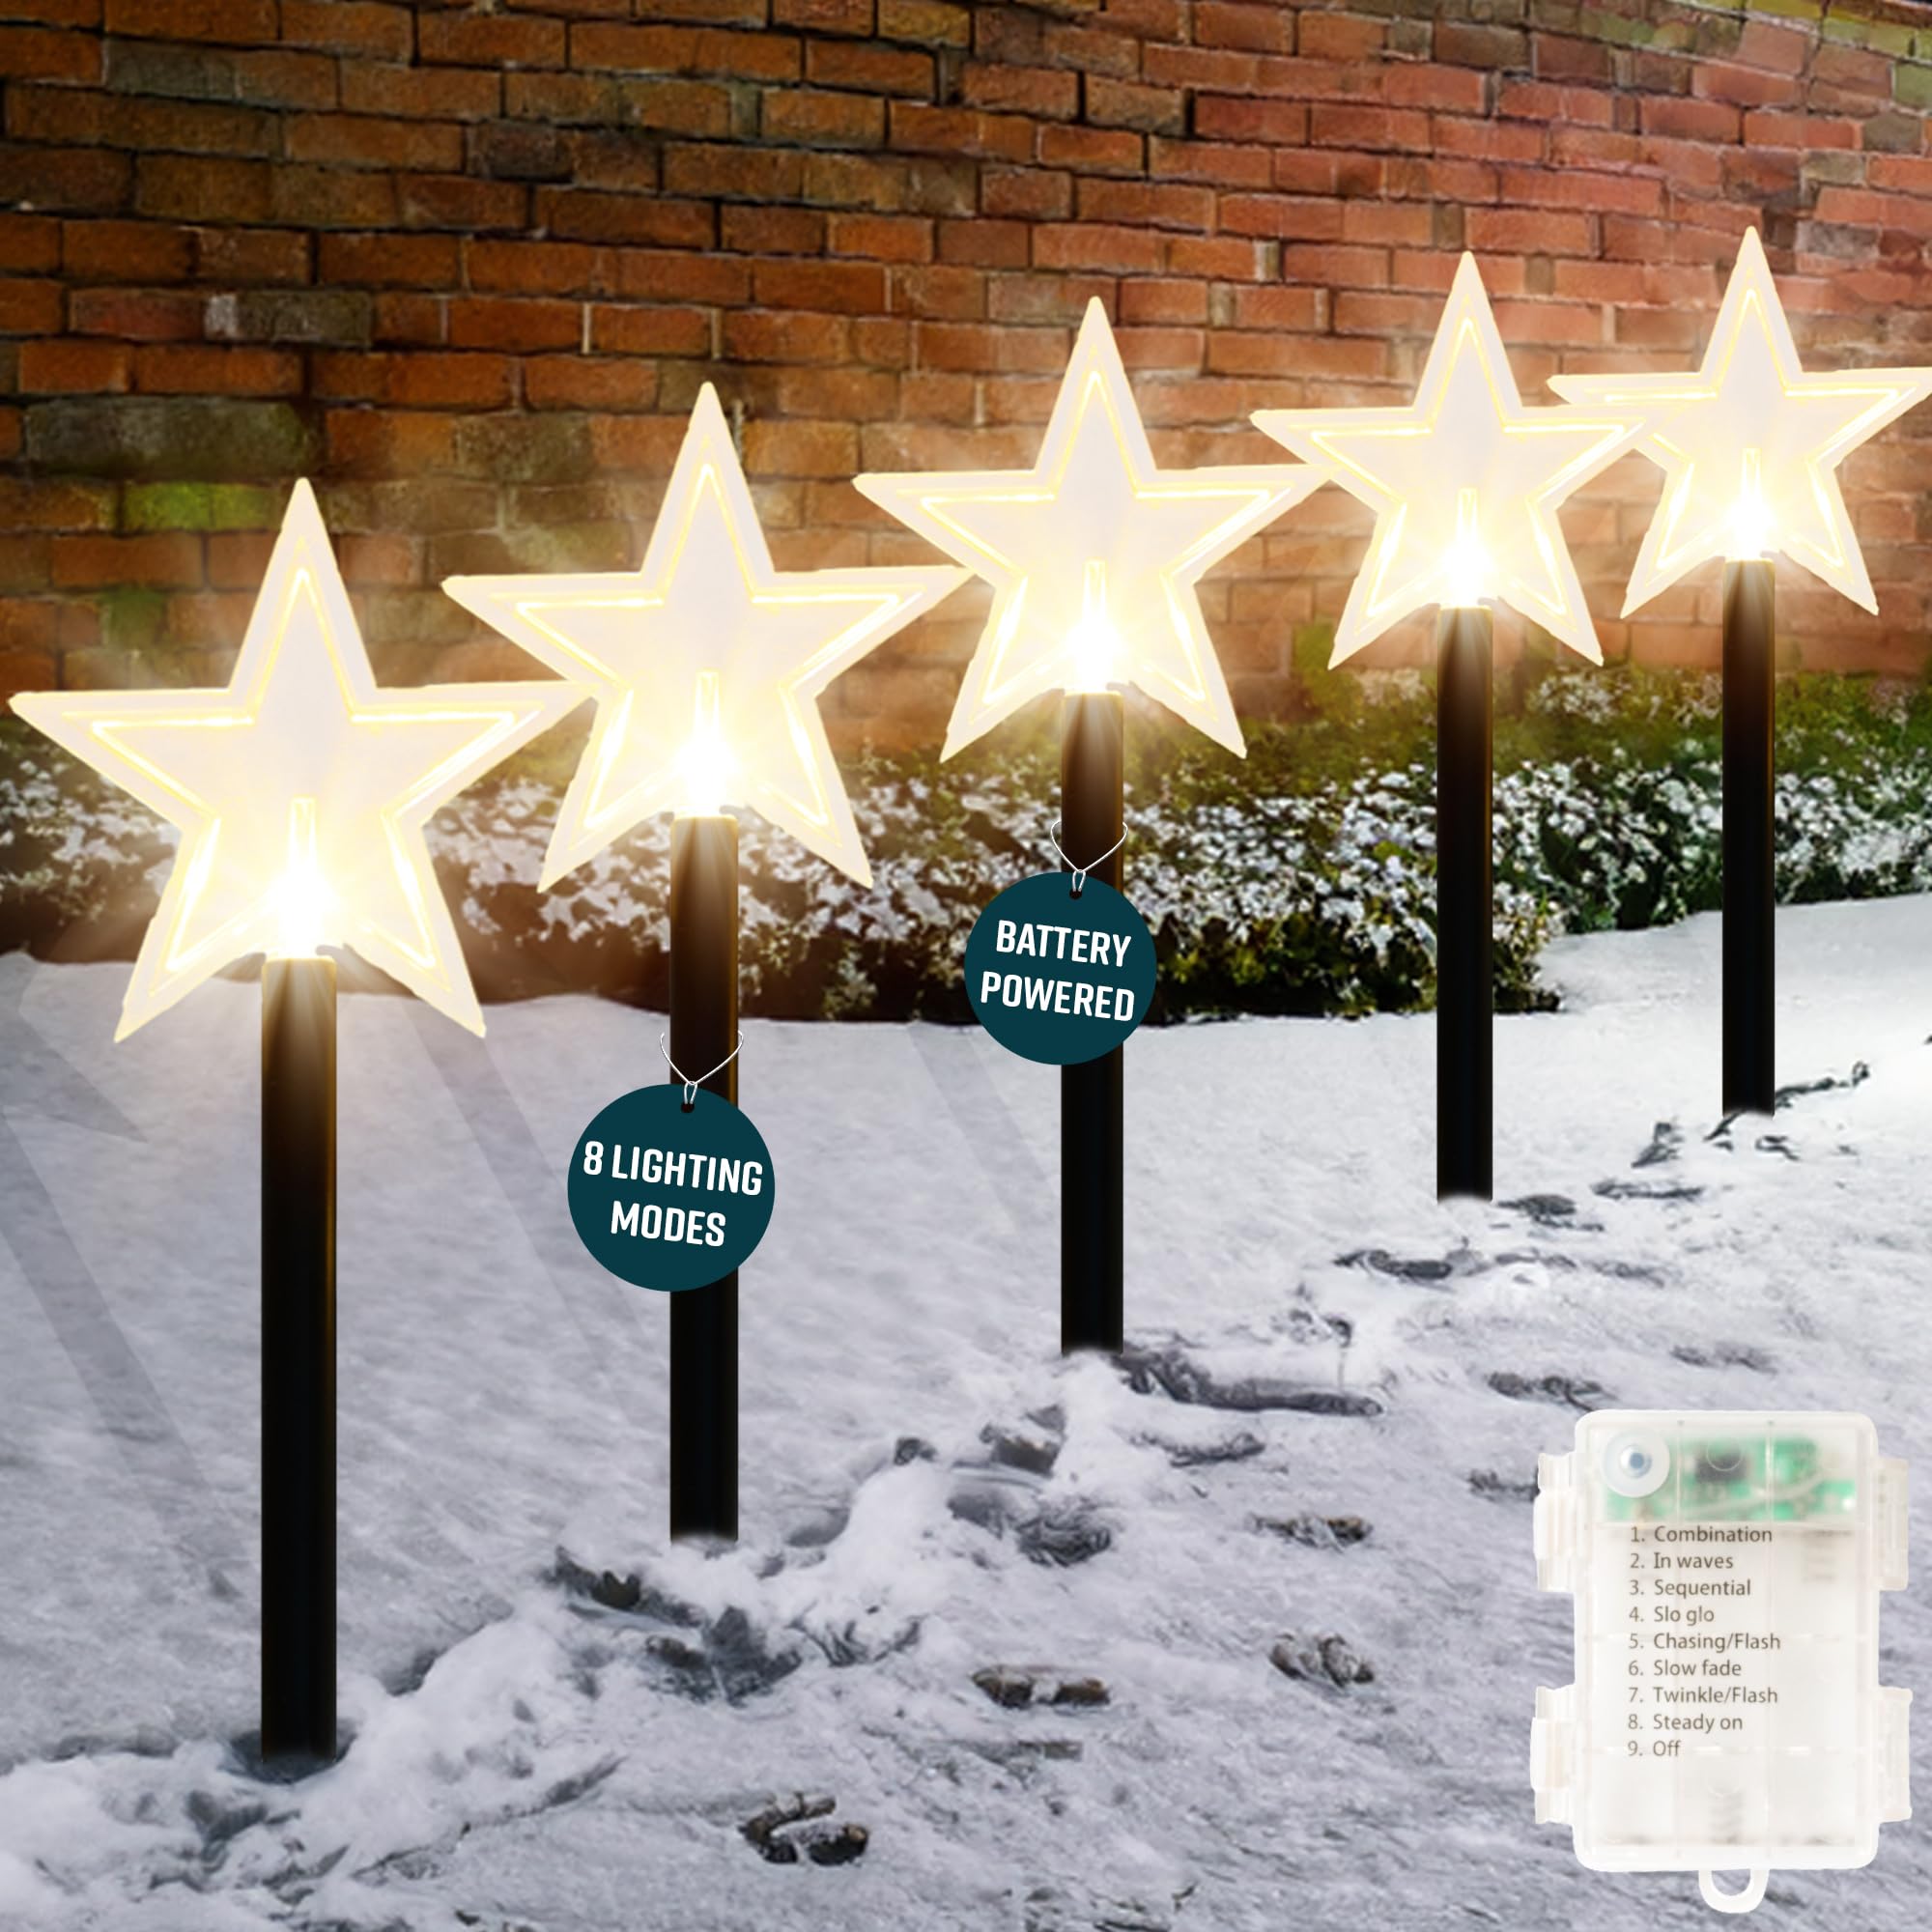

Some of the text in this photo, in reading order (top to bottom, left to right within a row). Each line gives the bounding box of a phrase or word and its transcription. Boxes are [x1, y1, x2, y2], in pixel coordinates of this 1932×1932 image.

[1632, 1525, 1772, 1543] 1. Combination
[1631, 1552, 1733, 1569] 2. In waves
[1631, 1579, 1750, 1598] 3. Sequential
[1629, 1606, 1714, 1626] 4. Slo glo
[1630, 1633, 1780, 1652] 5. Chasing/Flash
[1629, 1660, 1742, 1676] 6. Slow fade
[1629, 1687, 1777, 1703] 7. Twinkle/Flash
[1629, 1714, 1743, 1734] 8. Steady on
[1628, 1740, 1681, 1756] 9. Off
